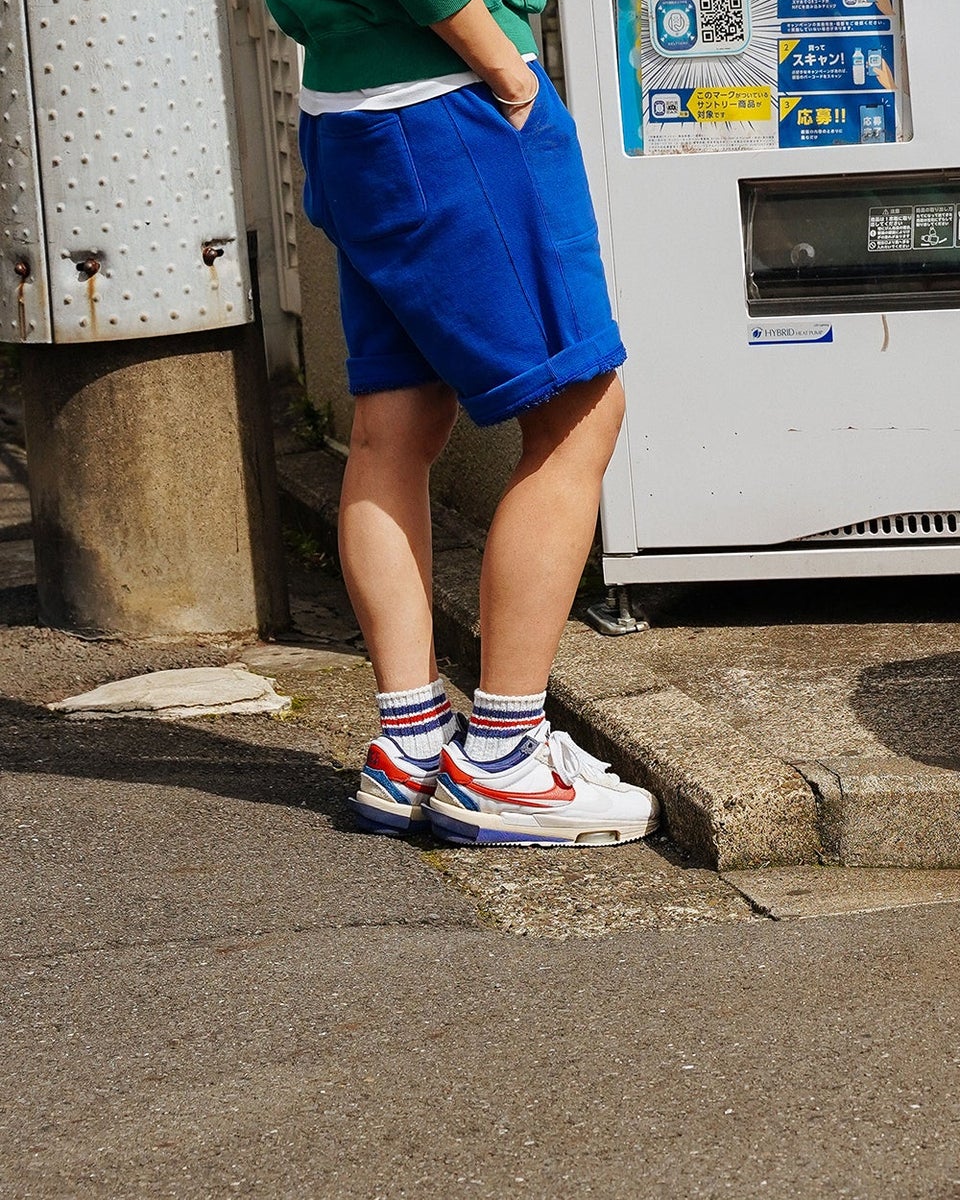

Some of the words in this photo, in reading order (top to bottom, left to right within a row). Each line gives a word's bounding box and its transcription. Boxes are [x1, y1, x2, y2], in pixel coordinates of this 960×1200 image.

[784, 43, 789, 51] 2
[808, 44, 825, 52] 買って
[792, 52, 845, 66] スキャン!
[696, 90, 768, 100] このマークがついている
[697, 99, 762, 109] サントリー商品が
[784, 101, 790, 109] 3
[697, 110, 726, 119] 対象です
[797, 108, 846, 126] 応募!!
[764, 328, 795, 338] HYBRID
